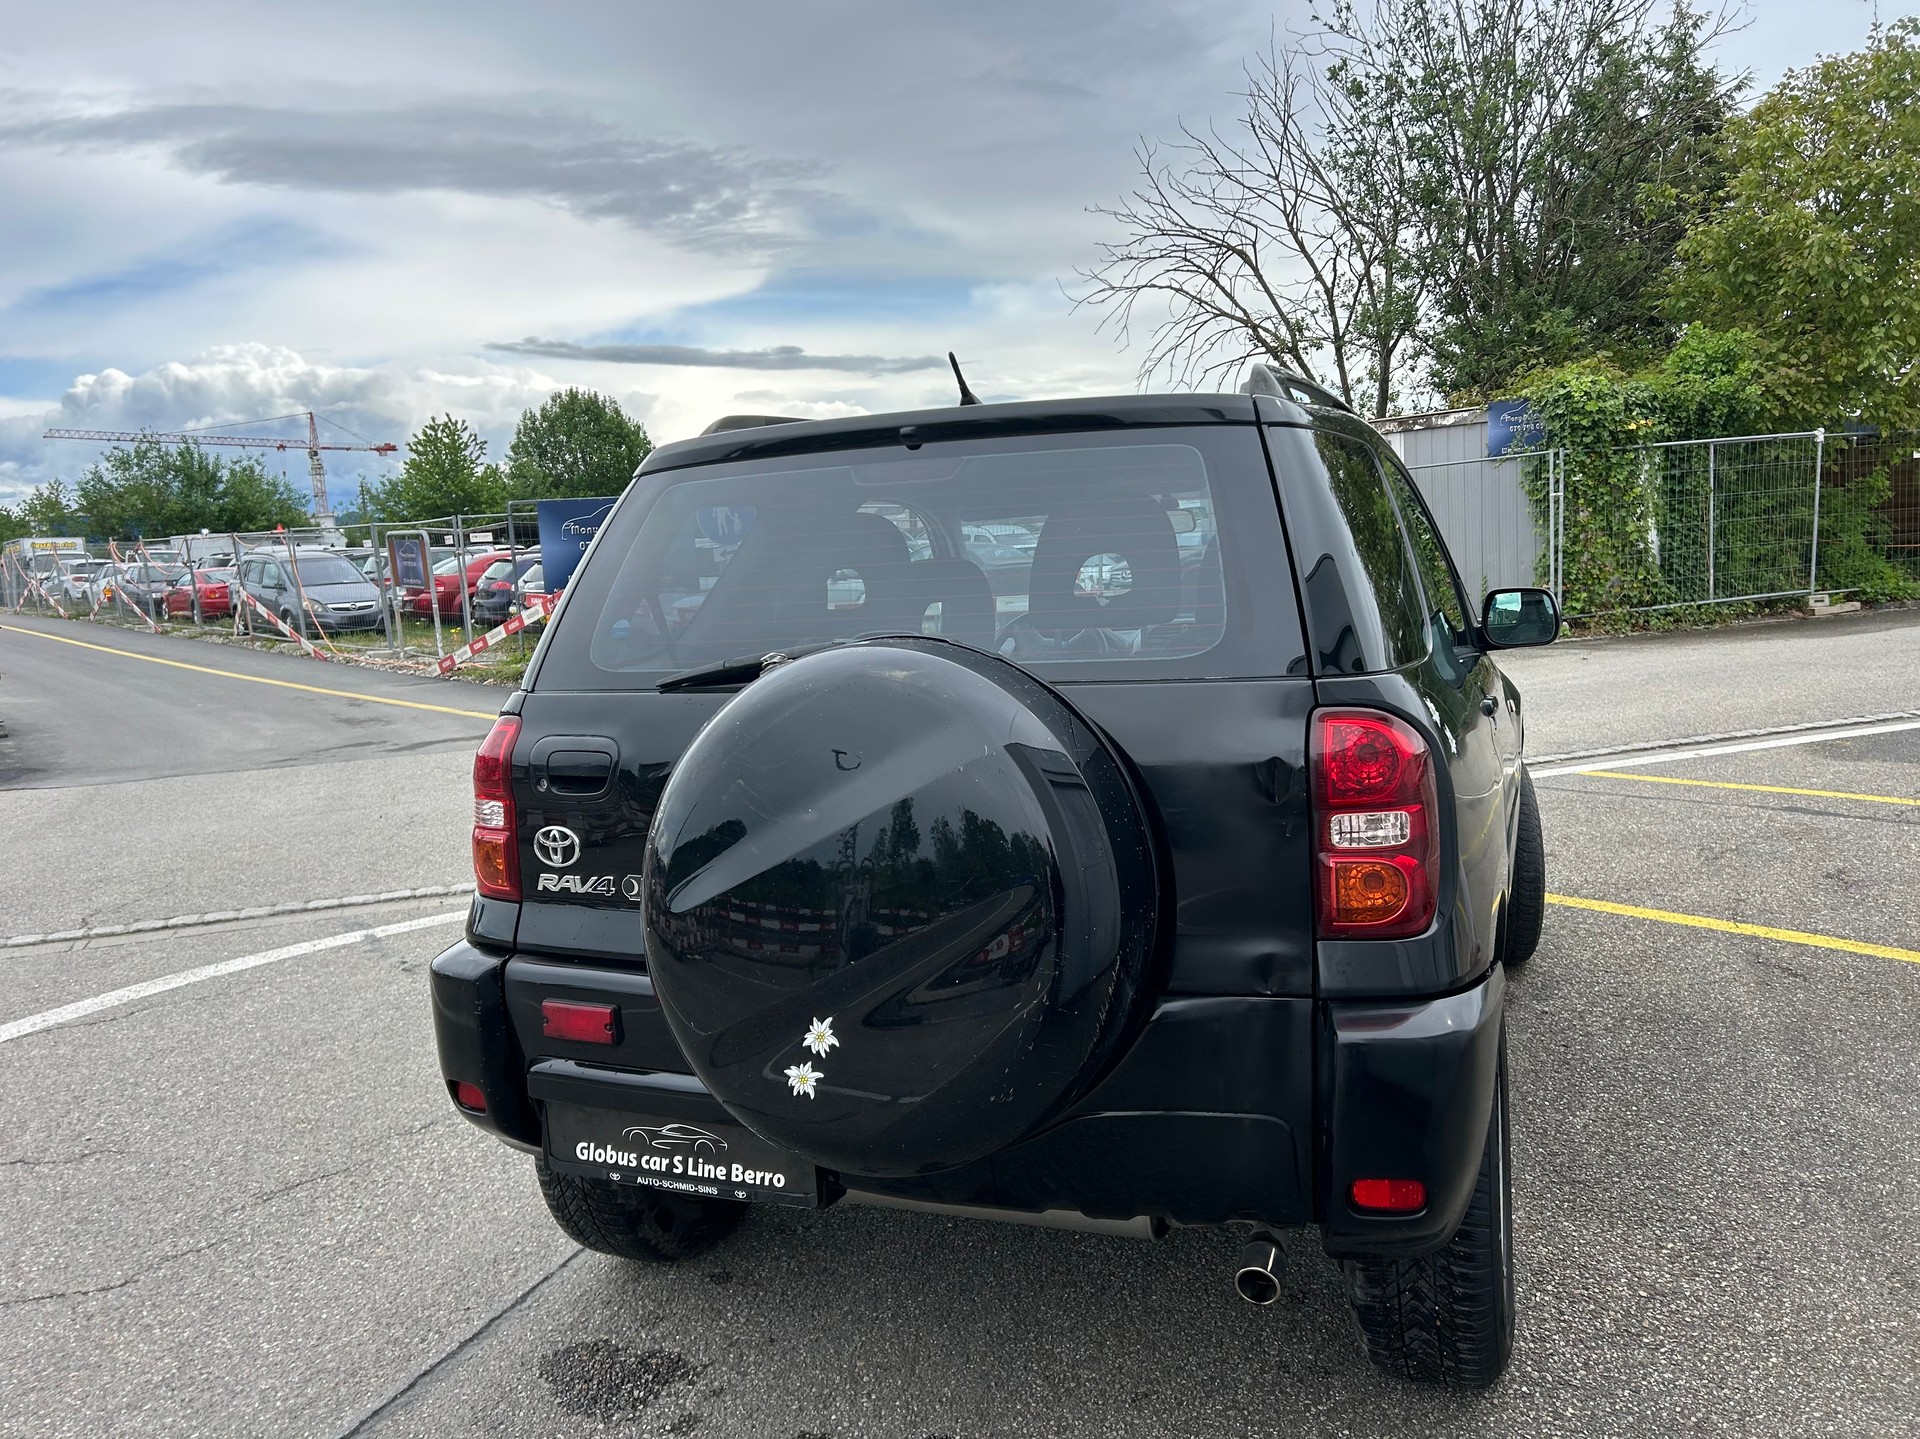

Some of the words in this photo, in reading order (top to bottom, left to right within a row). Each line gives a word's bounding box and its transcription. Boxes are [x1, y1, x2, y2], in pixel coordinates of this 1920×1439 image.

[537, 873, 616, 896] RAV4
[575, 1141, 638, 1168] Globus
[640, 1155, 670, 1172] car
[672, 1155, 684, 1174] S
[687, 1157, 727, 1181] Line
[731, 1163, 786, 1188] Berro
[636, 1176, 719, 1196] AUTO-SCHMID-SINS
